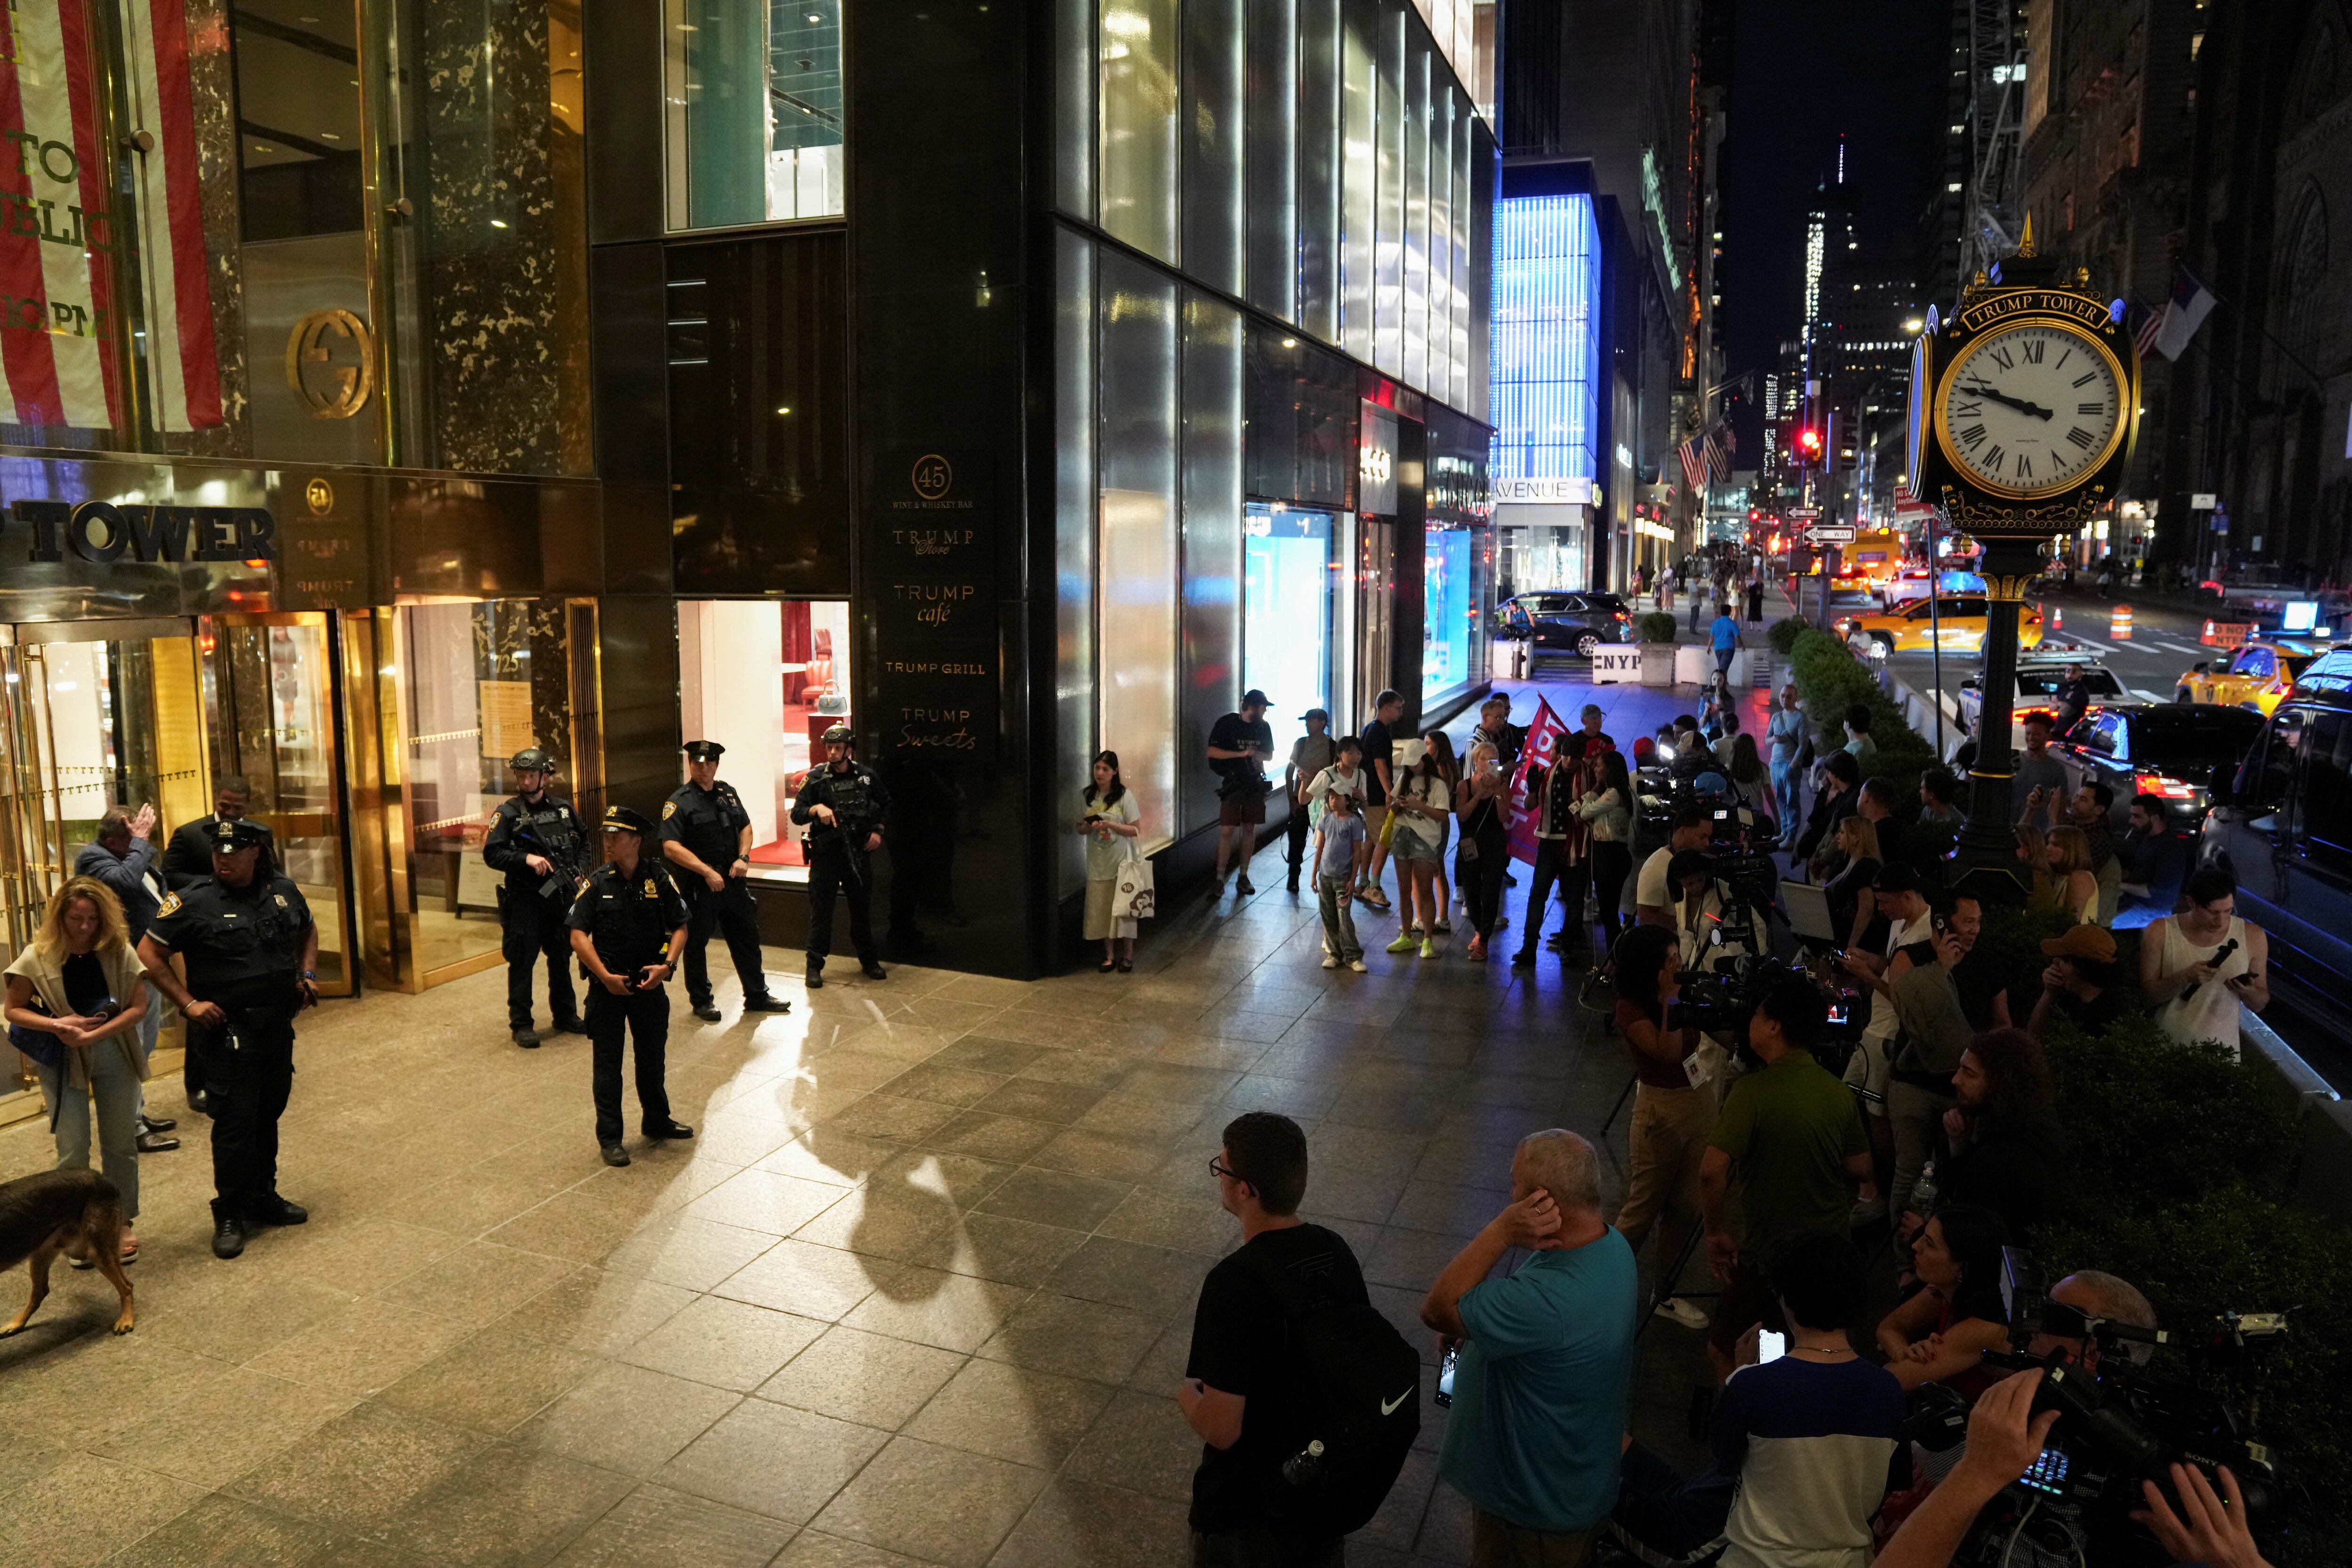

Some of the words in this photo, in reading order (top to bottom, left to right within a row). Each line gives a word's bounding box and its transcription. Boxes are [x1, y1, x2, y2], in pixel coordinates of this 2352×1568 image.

[5, 128, 79, 184] TO
[1972, 295, 2032, 323] TRUMP
[2040, 295, 2097, 321] TOWER
[919, 466, 945, 487] 45
[10, 500, 276, 562] TOWER
[893, 531, 973, 544] TRUMP
[1835, 529, 1851, 538] WAY
[894, 586, 974, 600] TRUMP
[918, 602, 950, 627] café
[885, 662, 938, 673] TRUMP
[942, 664, 985, 675] GRILL
[901, 708, 970, 722] TRUMP
[897, 724, 976, 750] Sweets
[2184, 1451, 2217, 1466] SONY
